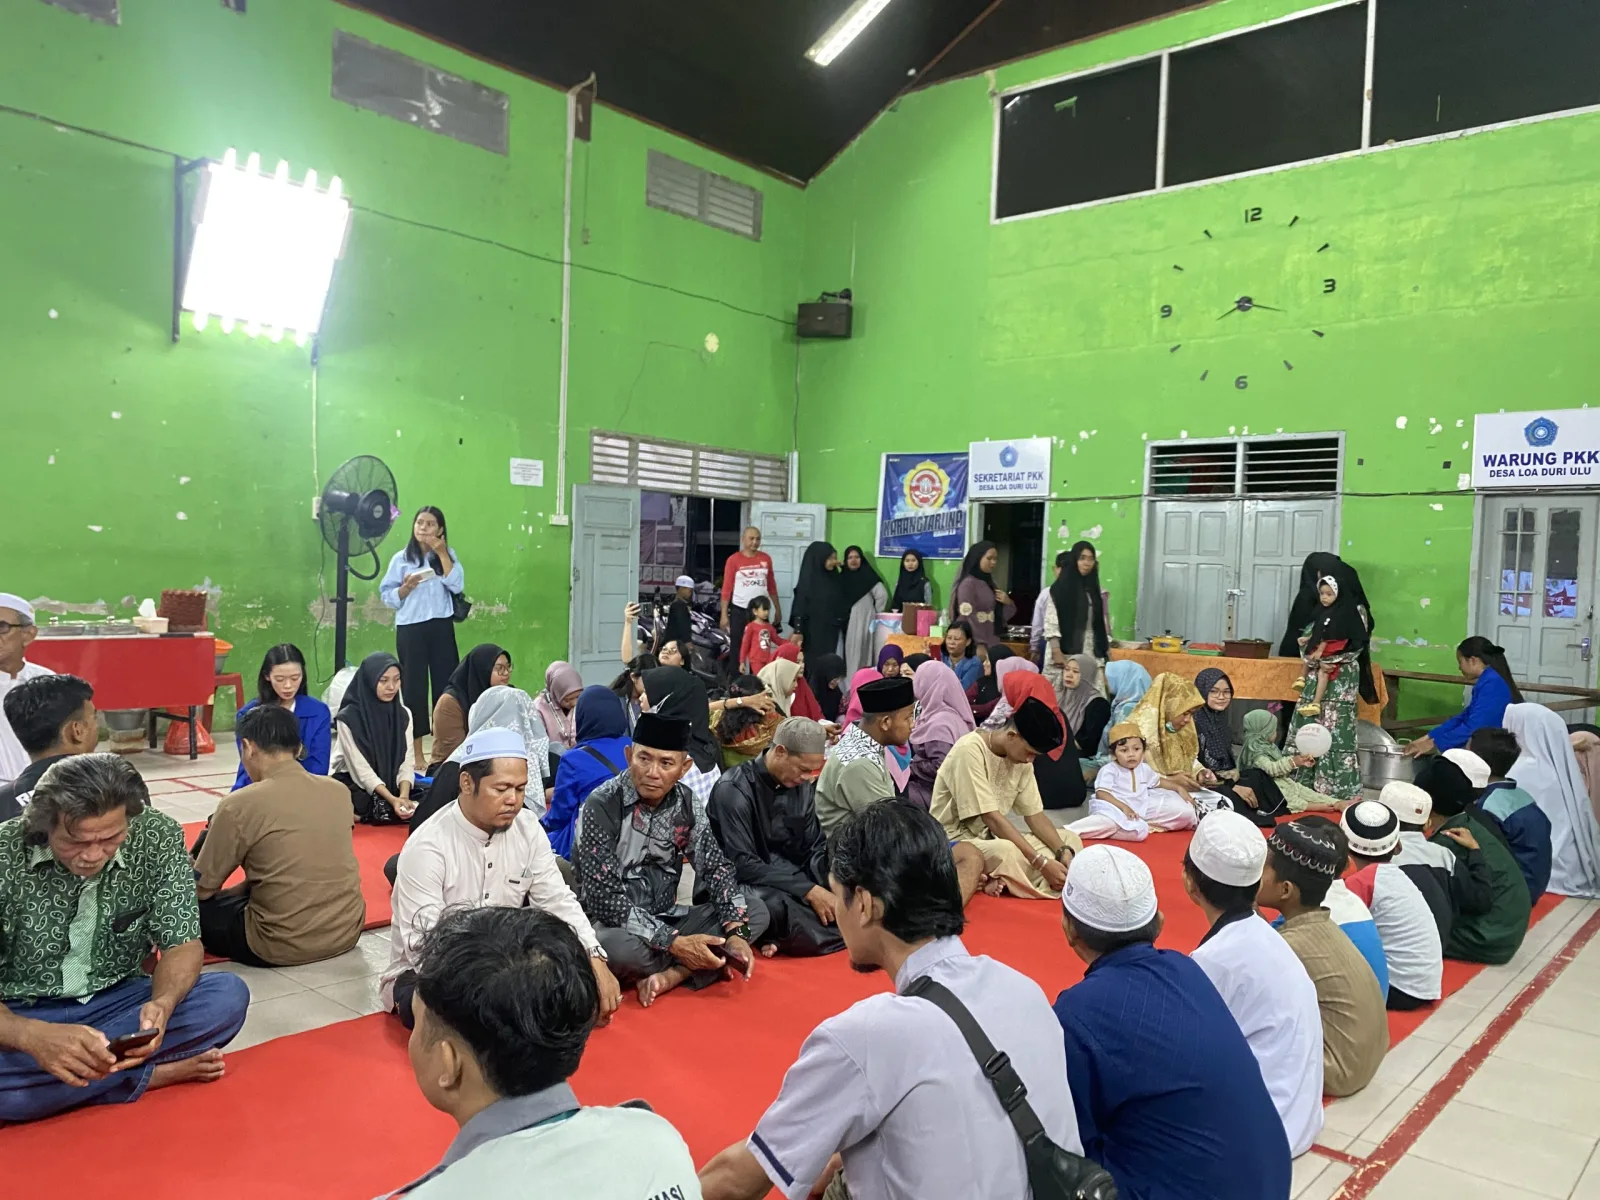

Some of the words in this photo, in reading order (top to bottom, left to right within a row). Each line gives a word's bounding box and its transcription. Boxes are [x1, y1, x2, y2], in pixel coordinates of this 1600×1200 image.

[1244, 207, 1262, 223] 12
[1323, 278, 1336, 293] 3
[1160, 304, 1172, 318] 9
[1234, 375, 1248, 389] 6
[1483, 453, 1557, 467] WARUNG
[1563, 451, 1599, 464] PKK
[974, 471, 1026, 483] SEKRETARIAT
[1027, 471, 1044, 481] PKK
[1489, 469, 1516, 477] DESA
[1519, 468, 1538, 477] LOA
[1541, 467, 1566, 476] DURI
[1570, 467, 1591, 475] ULU
[996, 483, 1007, 491] LOA
[1026, 482, 1038, 490] ULU
